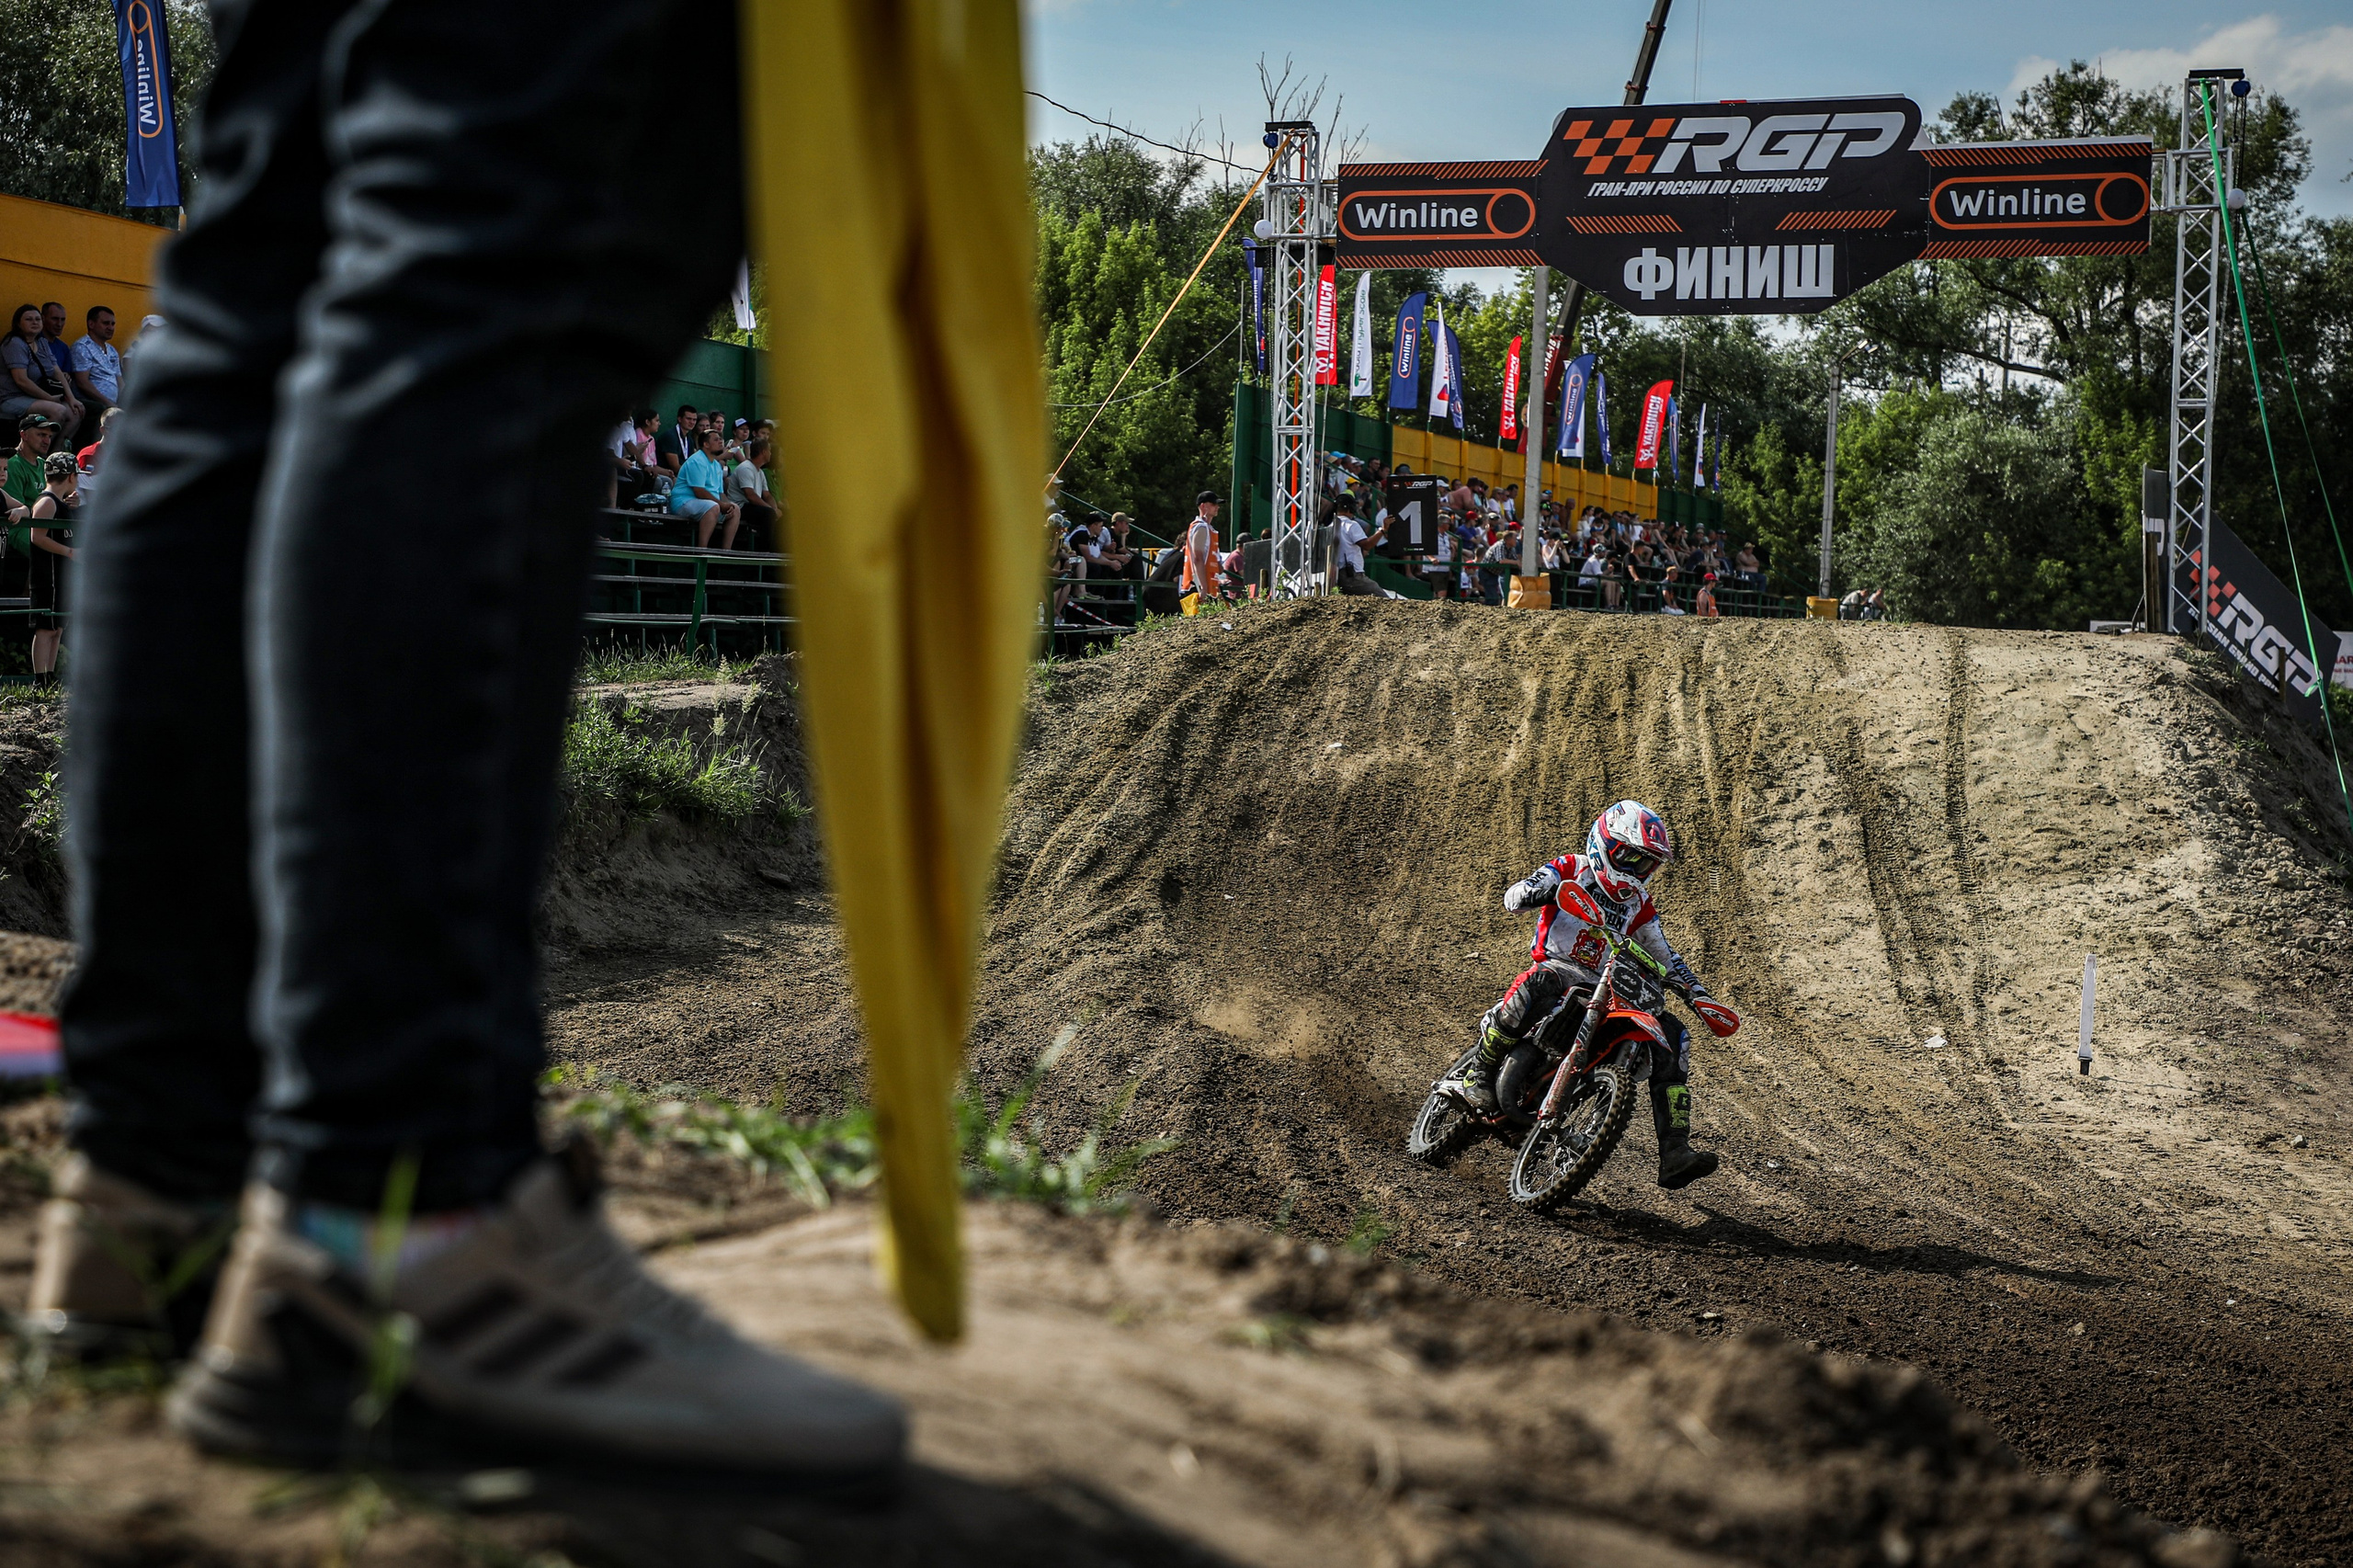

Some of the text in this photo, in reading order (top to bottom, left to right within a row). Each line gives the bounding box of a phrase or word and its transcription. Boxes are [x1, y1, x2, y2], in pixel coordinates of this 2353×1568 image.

[1652, 112, 1905, 173] RGP
[1587, 176, 1830, 196] ГРАН-ПРИ РОССИИ ПО СУПЕРКРОССУ
[1949, 187, 2086, 217] Winline
[1356, 202, 1478, 228] Winline
[1623, 244, 1835, 300] ФИНИШ
[1314, 280, 1334, 352] YAKHNICH
[1401, 334, 1413, 373] Winline
[1643, 395, 1662, 447] YAKHNICH
[1398, 501, 1422, 544] 1
[2217, 592, 2324, 695] RGP
[2228, 644, 2260, 677] GRAND
